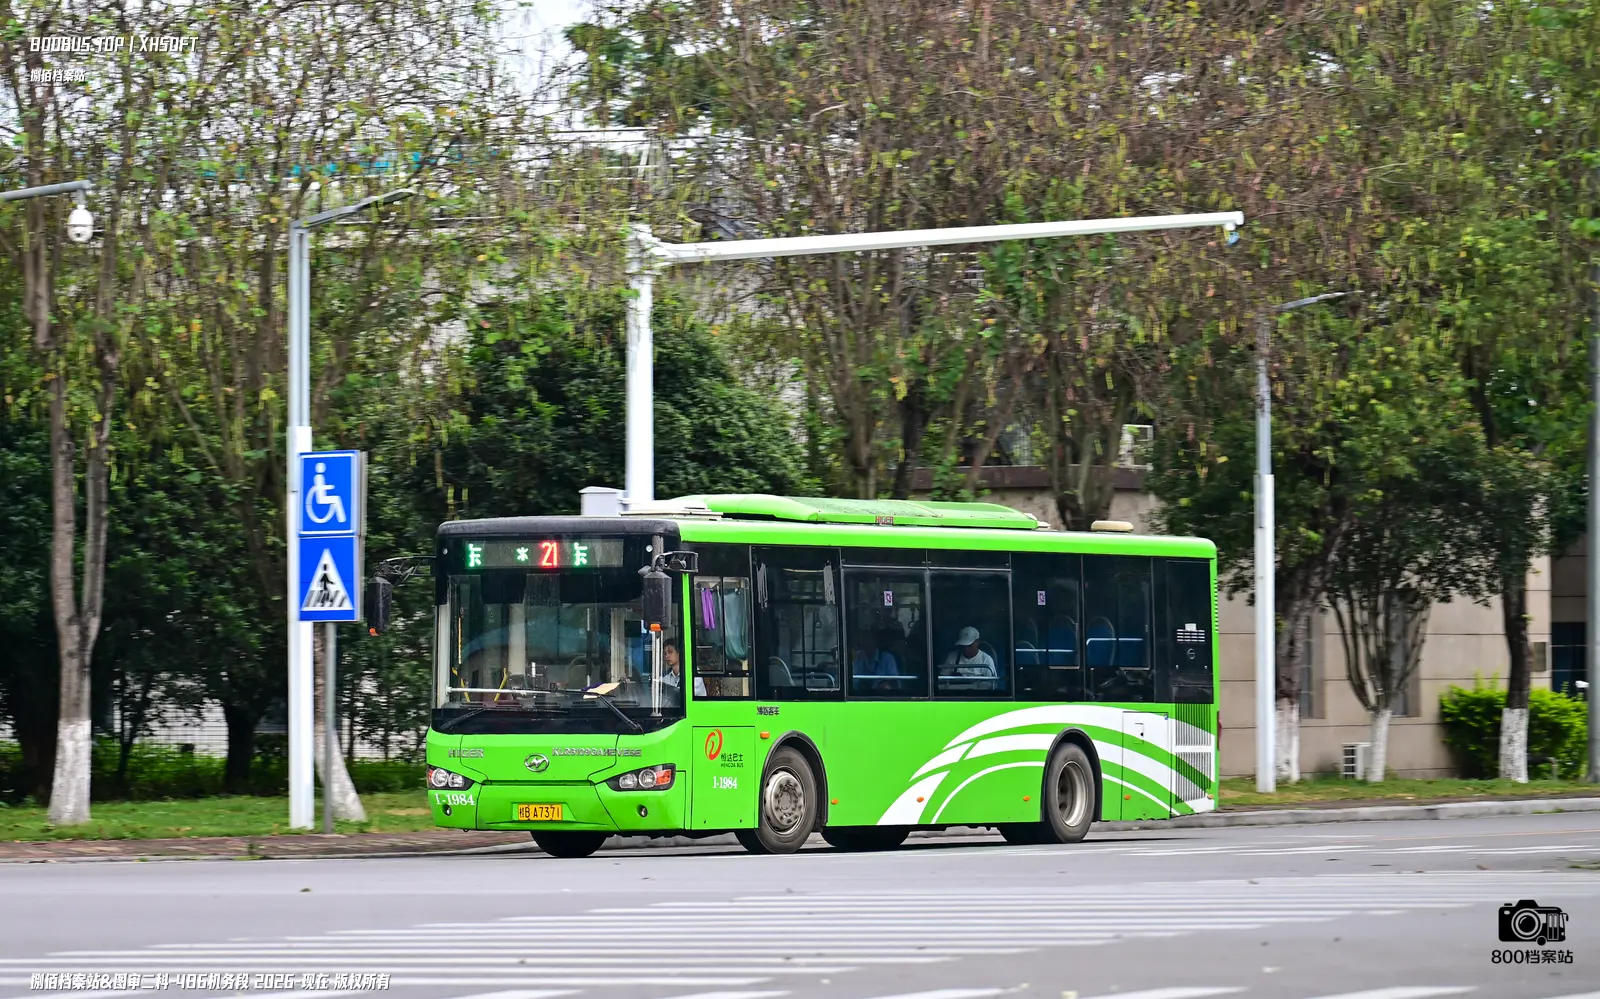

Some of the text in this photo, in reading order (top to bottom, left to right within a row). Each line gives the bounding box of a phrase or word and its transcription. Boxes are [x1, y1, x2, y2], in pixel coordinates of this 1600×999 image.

[875, 515, 894, 525] HIGER
[448, 748, 484, 759] HIGER
[720, 753, 744, 762] 恒达巴士
[434, 793, 475, 806] 1-1984
